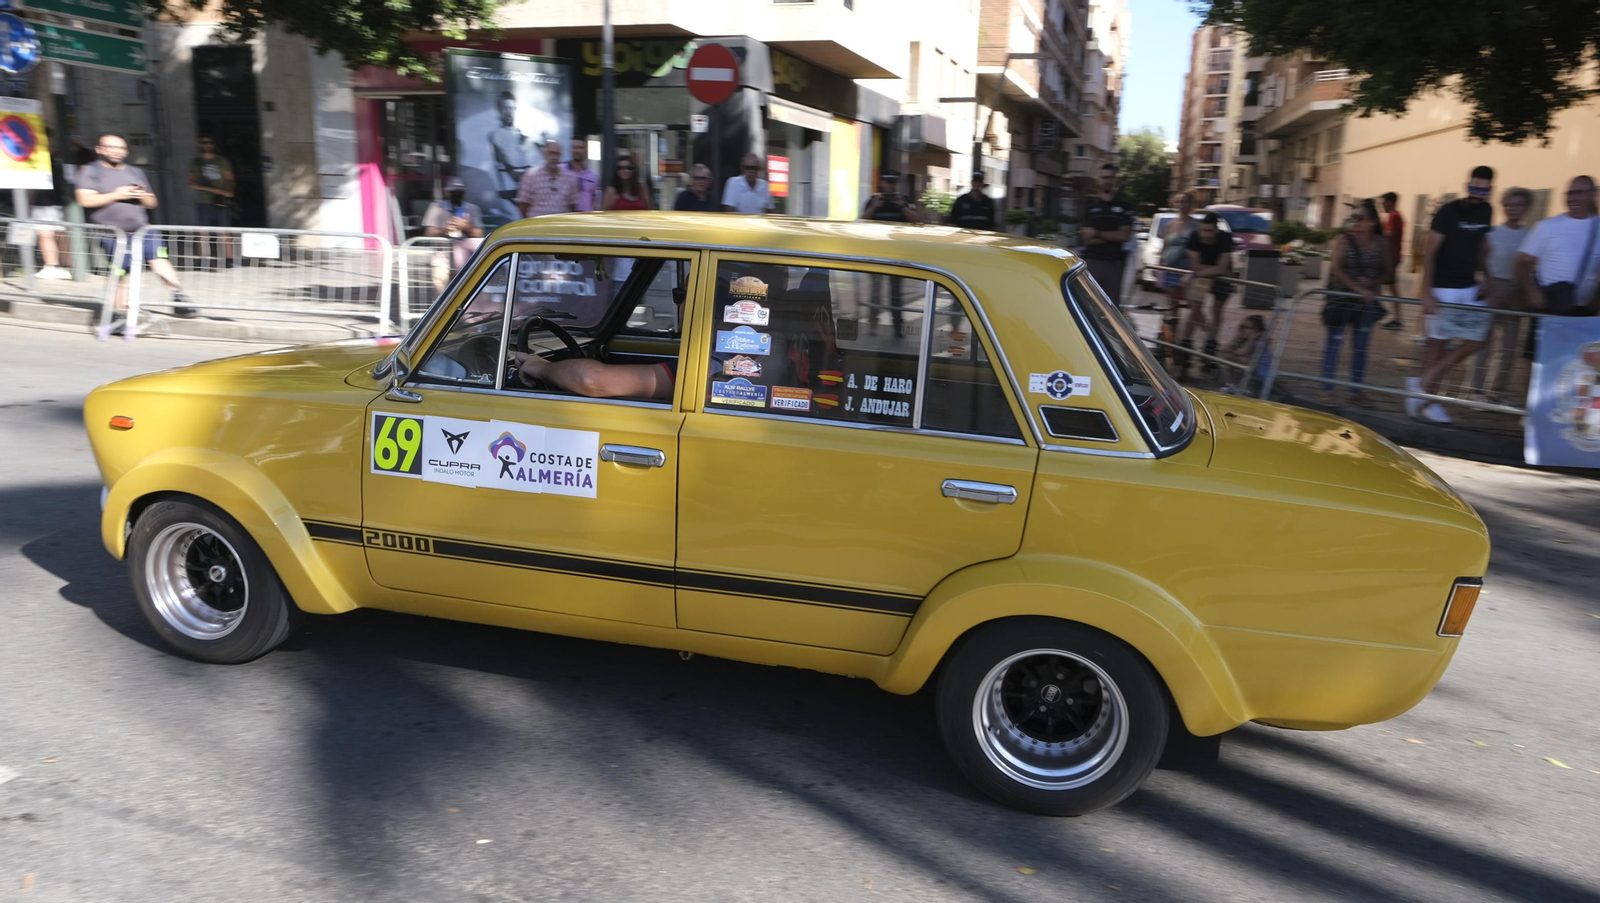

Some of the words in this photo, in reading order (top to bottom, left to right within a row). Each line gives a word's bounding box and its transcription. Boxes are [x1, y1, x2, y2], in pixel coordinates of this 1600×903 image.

[518, 260, 584, 279] grupo
[847, 373, 859, 389] A.
[864, 374, 879, 392] DE
[883, 377, 913, 395] HARO
[721, 398, 756, 408] VERIFICADO
[773, 398, 809, 410] VERIFICADO
[844, 395, 855, 412] J.
[860, 397, 911, 418] ANDUJAR
[373, 416, 422, 473] 69
[428, 459, 481, 472] CUPRA
[529, 452, 574, 468] COSTA
[575, 456, 593, 470] DE
[433, 467, 455, 476] INDALO
[454, 469, 476, 478] MOTOR
[516, 466, 594, 490] ALMERÍA
[365, 530, 431, 553] 2000
